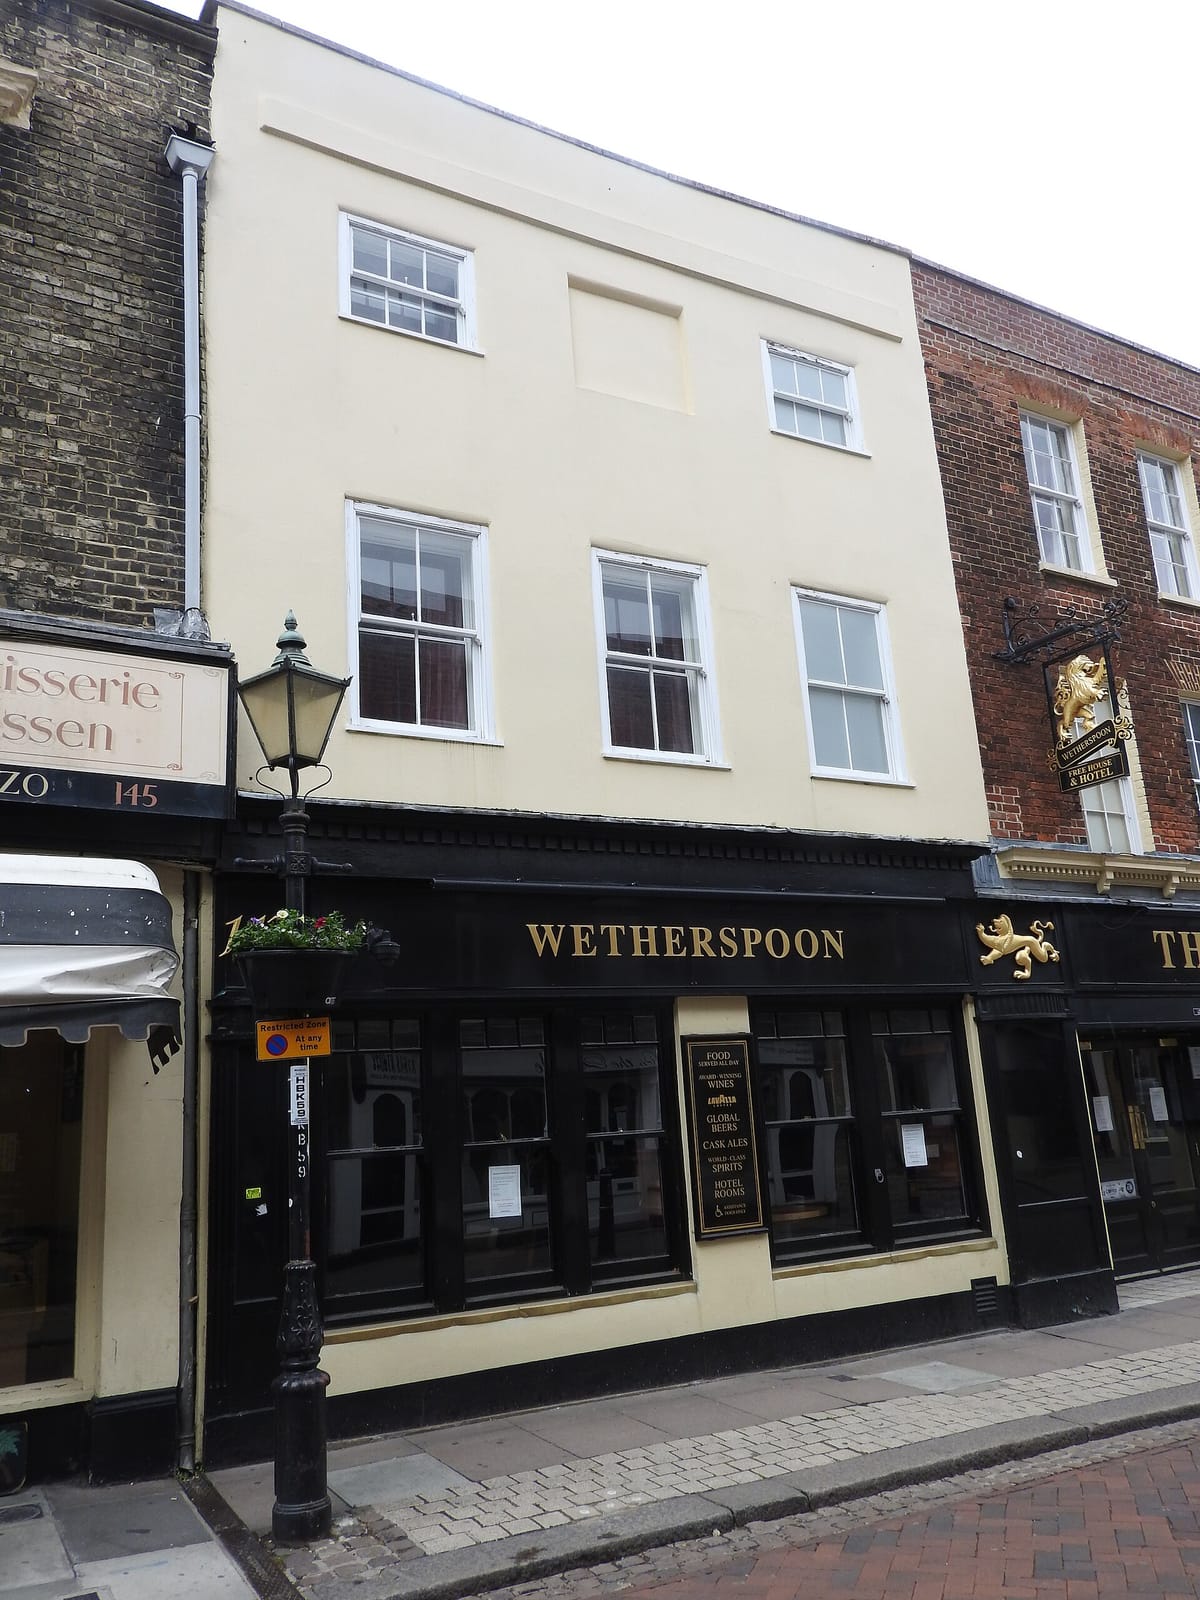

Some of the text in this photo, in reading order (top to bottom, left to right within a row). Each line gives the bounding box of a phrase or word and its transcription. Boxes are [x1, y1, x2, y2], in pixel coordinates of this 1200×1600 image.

[0, 656, 159, 708] isserie
[0, 713, 112, 750] ssen
[1061, 726, 1111, 760] WETHERSPOON
[1069, 759, 1113, 777] FREE HOUSE
[1070, 767, 1114, 787] & HOTEL
[115, 781, 158, 808] 145
[526, 923, 844, 960] WETHERSPOON
[260, 1021, 327, 1032] Restricted Zone
[307, 1034, 322, 1042] any
[300, 1043, 318, 1051] time
[706, 1051, 731, 1060] FOOD
[708, 1079, 735, 1089] WINES
[706, 1112, 740, 1124] GLOBAL
[711, 1122, 738, 1133] BEERS
[703, 1137, 748, 1150] CASK ALES
[712, 1162, 743, 1173] SPIRITS
[714, 1178, 743, 1190] HOTEL
[714, 1187, 745, 1199] ROOMS
